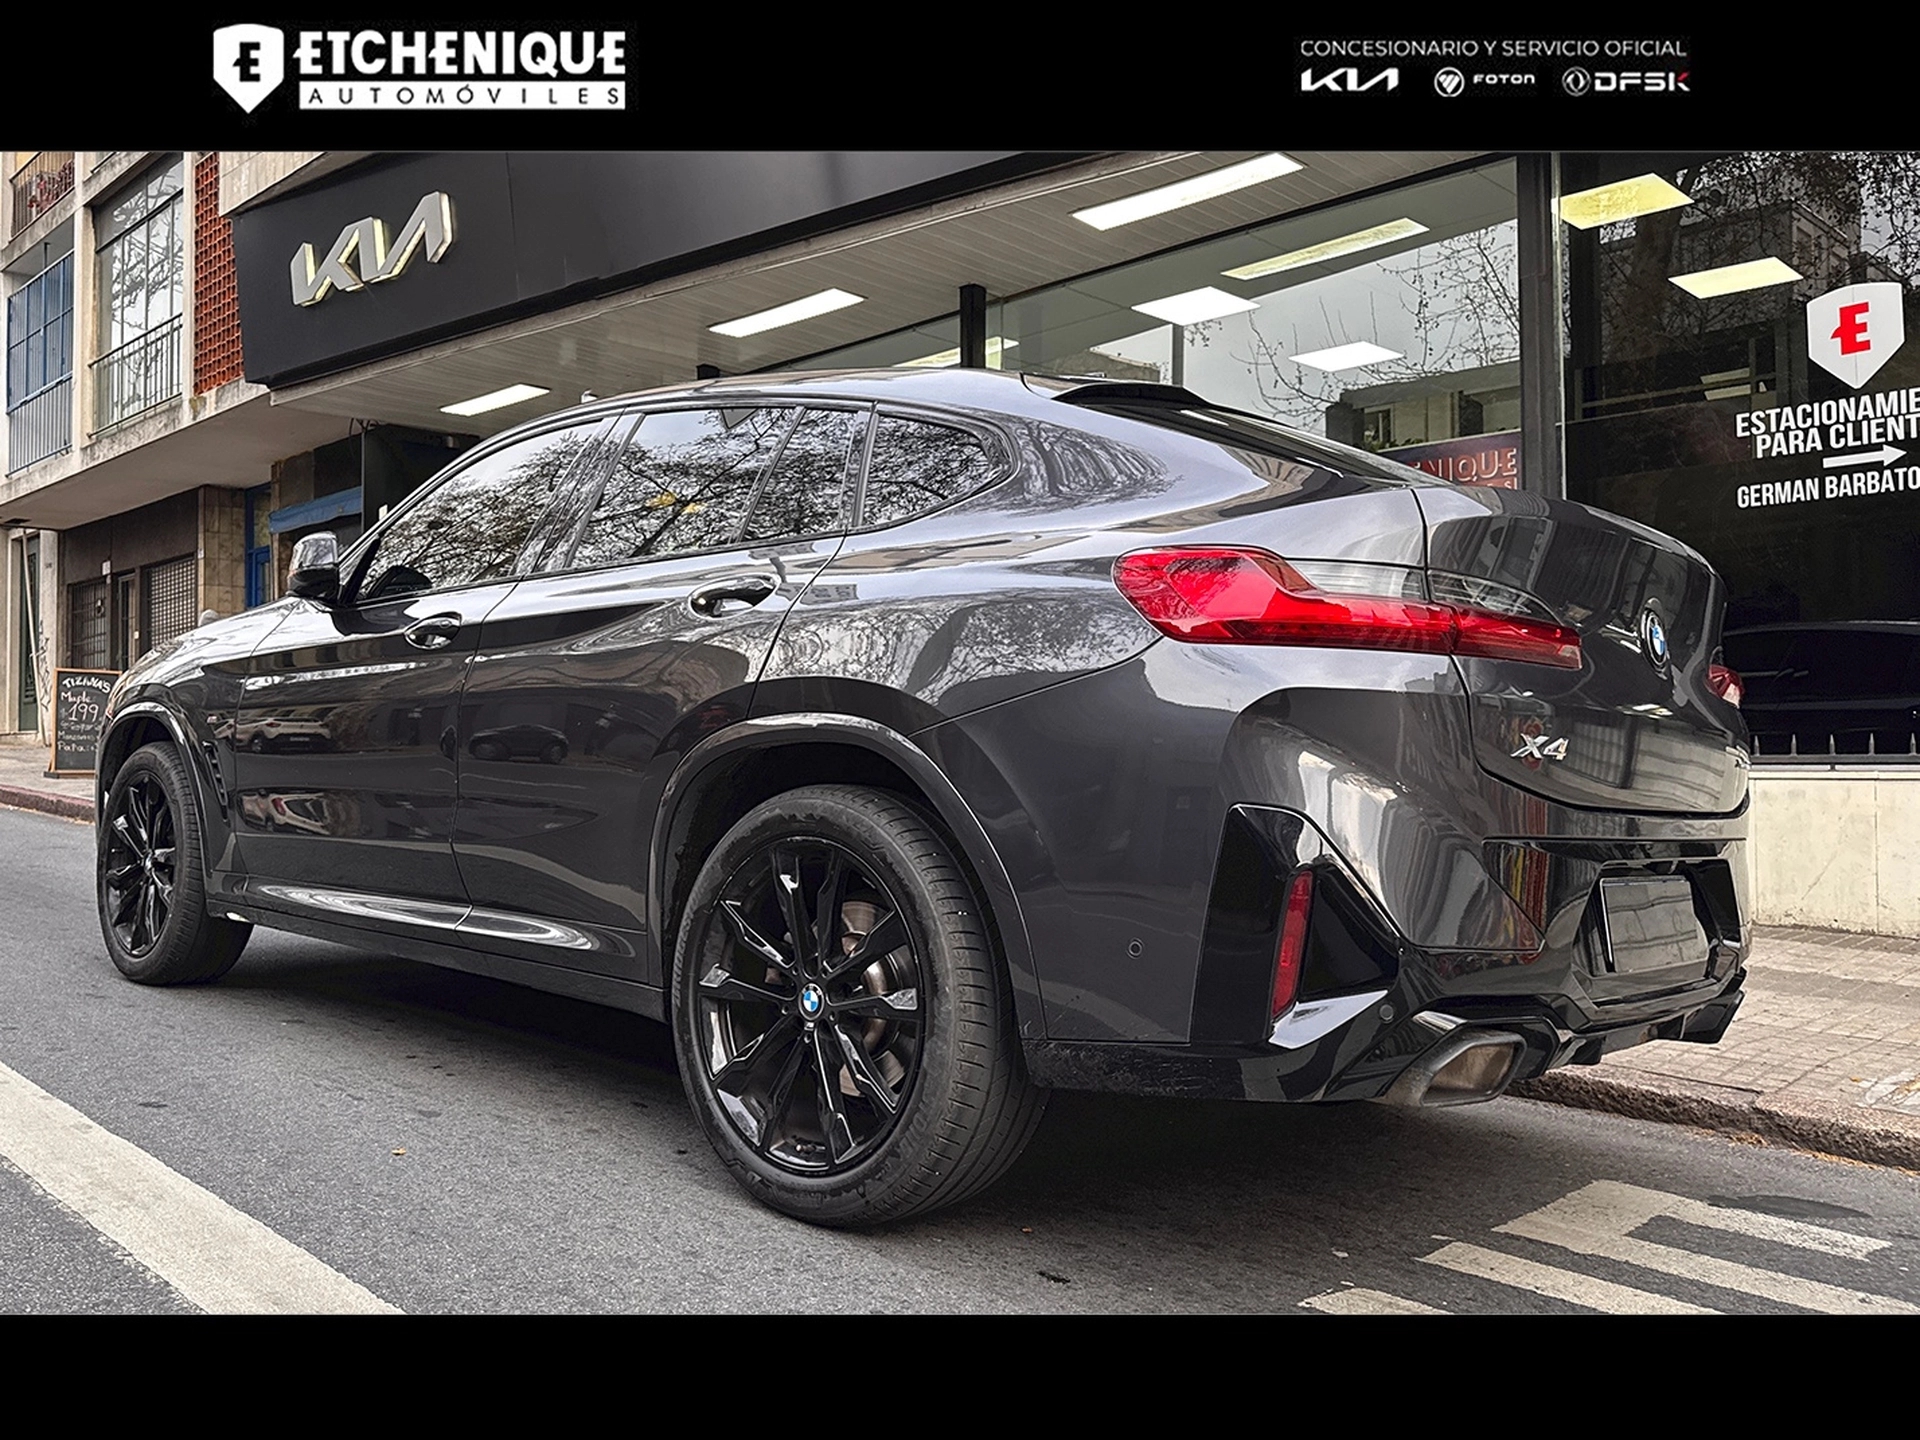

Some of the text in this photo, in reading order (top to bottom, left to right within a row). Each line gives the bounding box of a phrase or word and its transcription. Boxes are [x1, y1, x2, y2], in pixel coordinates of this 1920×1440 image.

[290, 191, 453, 307] KIA
[1829, 301, 1872, 356] E
[1756, 427, 1823, 459] PARA
[1736, 465, 1920, 509] GERMAN BARBATO
[1510, 733, 1570, 761] X4
